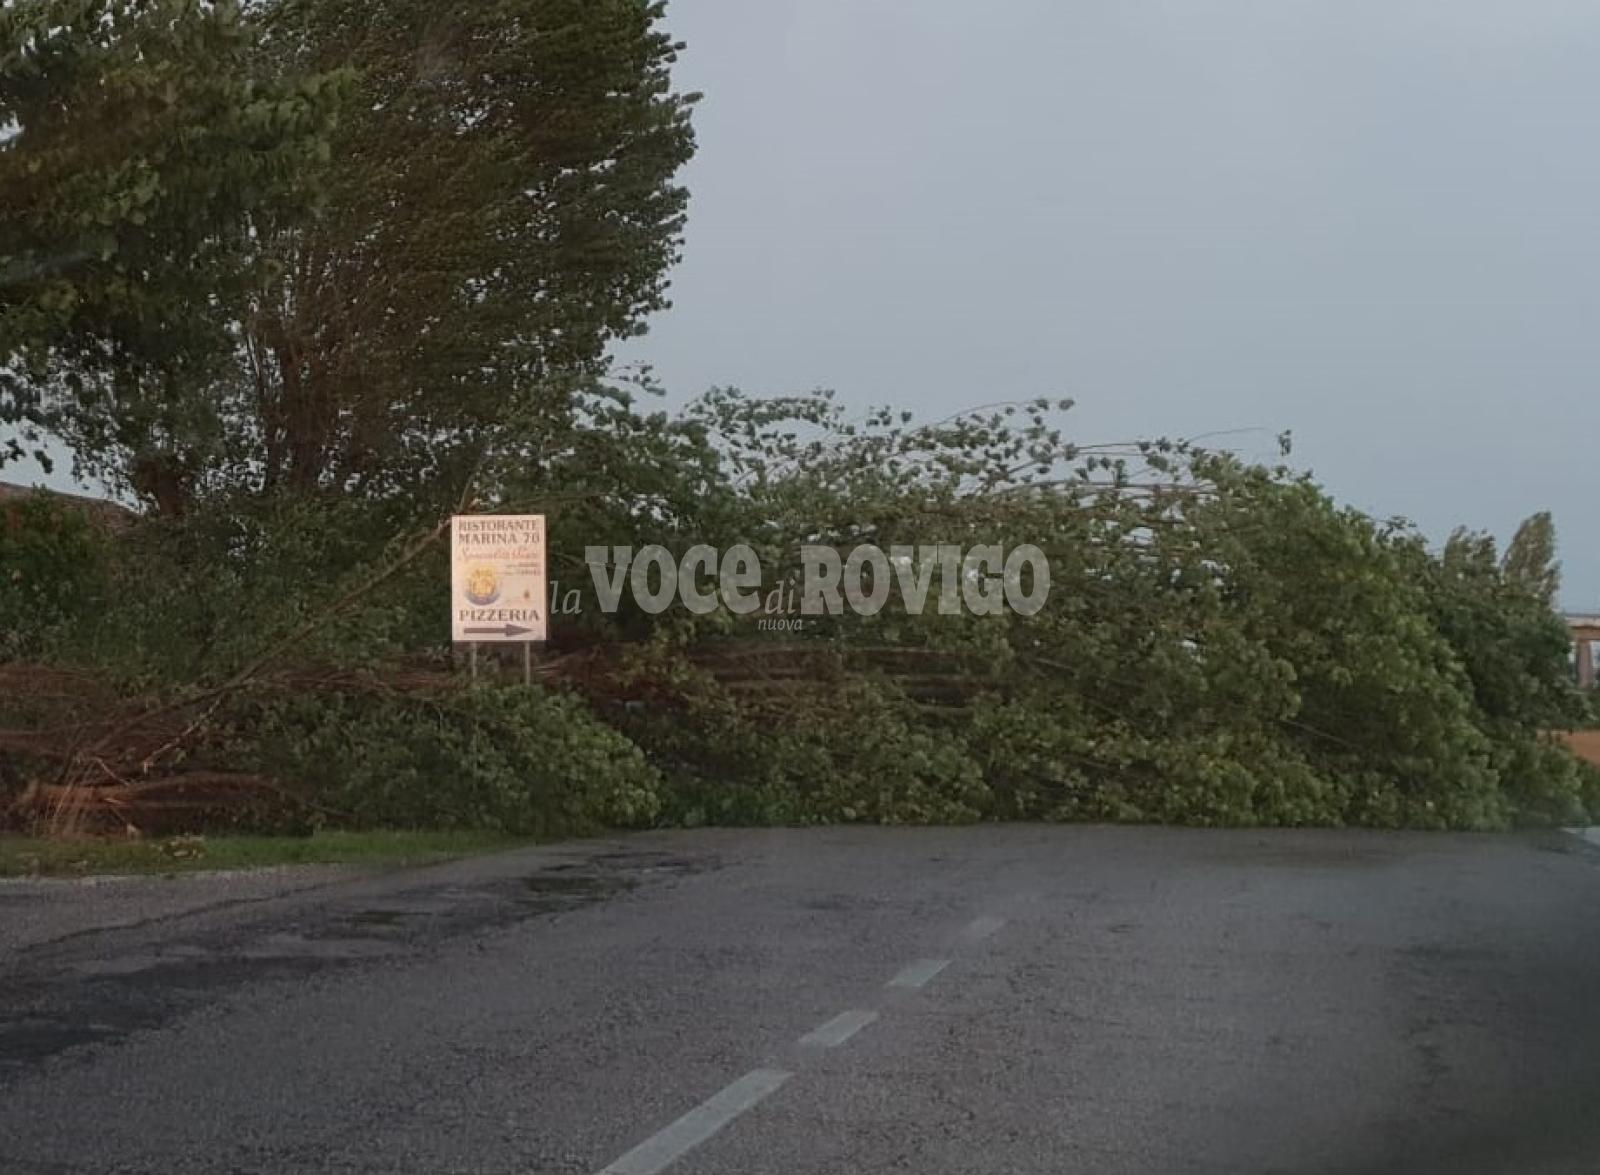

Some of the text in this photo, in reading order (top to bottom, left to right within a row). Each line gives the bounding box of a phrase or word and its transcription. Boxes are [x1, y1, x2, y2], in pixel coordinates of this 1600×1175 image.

[459, 519, 537, 532] RISTORANTE
[459, 533, 517, 545] MARINA
[459, 609, 540, 621] PIZZERIA
